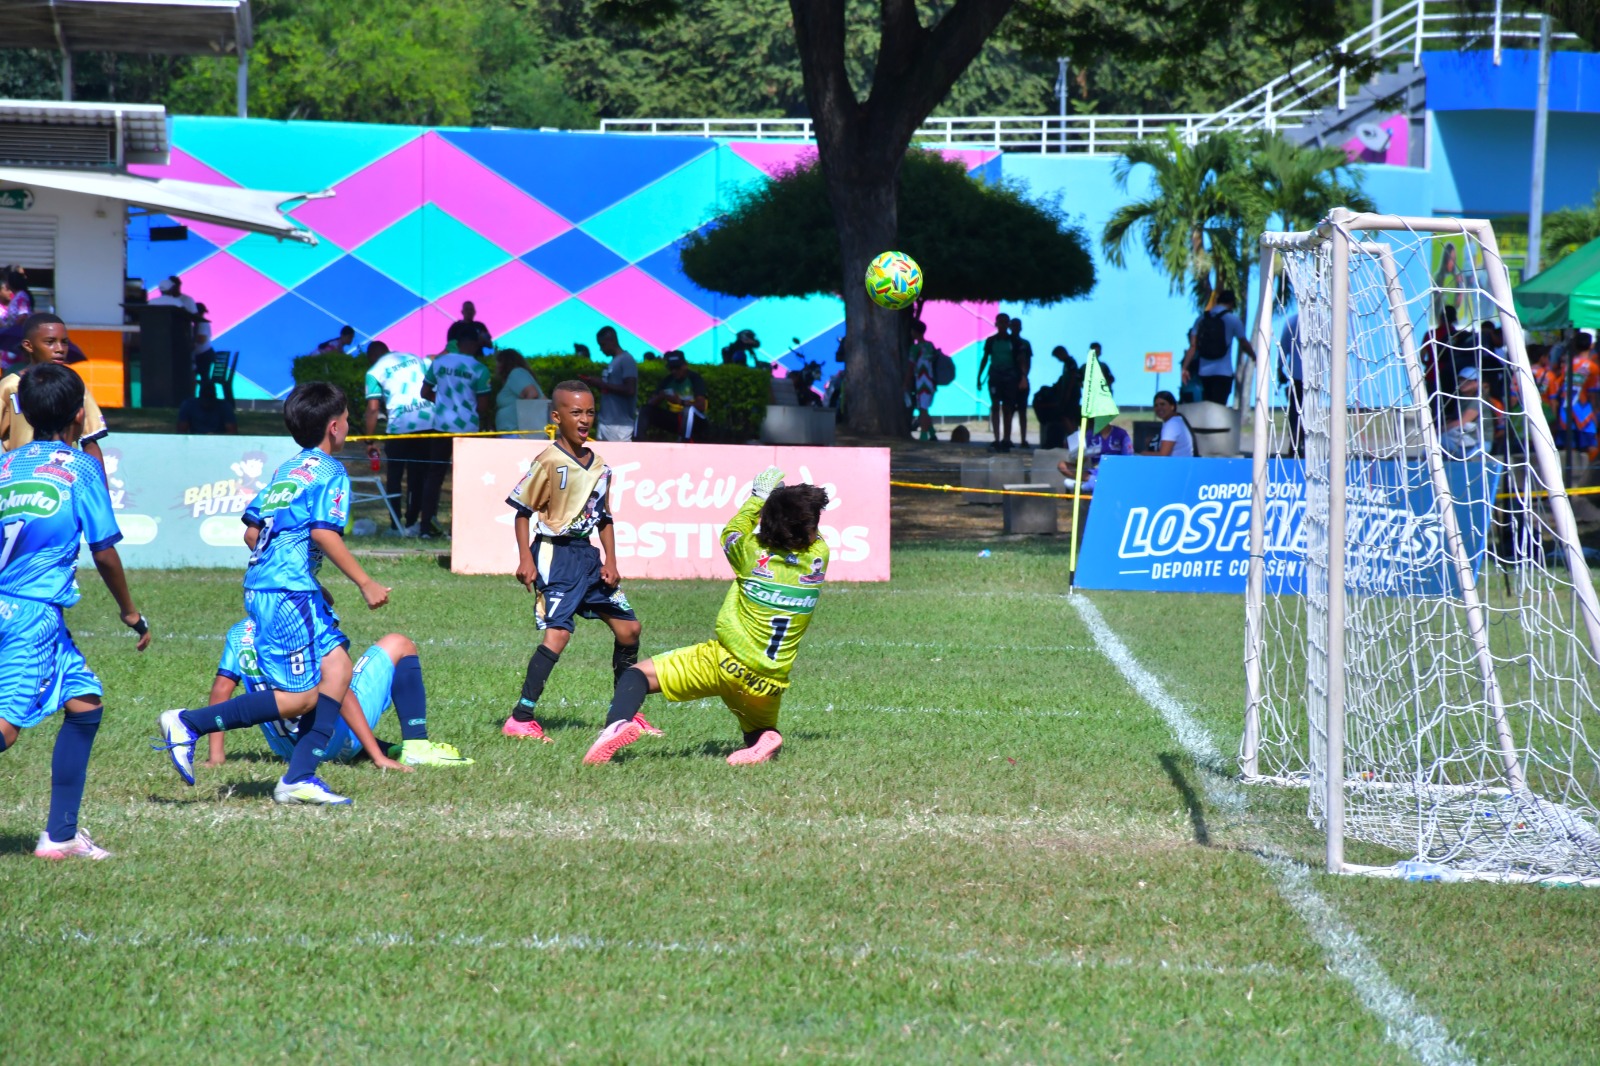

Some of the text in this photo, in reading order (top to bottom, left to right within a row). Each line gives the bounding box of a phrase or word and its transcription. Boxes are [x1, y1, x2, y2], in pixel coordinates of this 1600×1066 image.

[184, 479, 236, 505] BABY
[607, 461, 754, 513] Festiv
[1198, 482, 1303, 501] CORPOCION
[0, 489, 57, 511] olanta
[193, 495, 250, 518] FUTB
[1118, 501, 1223, 558] LOS
[1151, 560, 1223, 580] DEPORTE
[1228, 559, 1252, 577] CO
[548, 597, 562, 618] 7
[290, 650, 306, 676] 8
[719, 657, 746, 679] LOS
